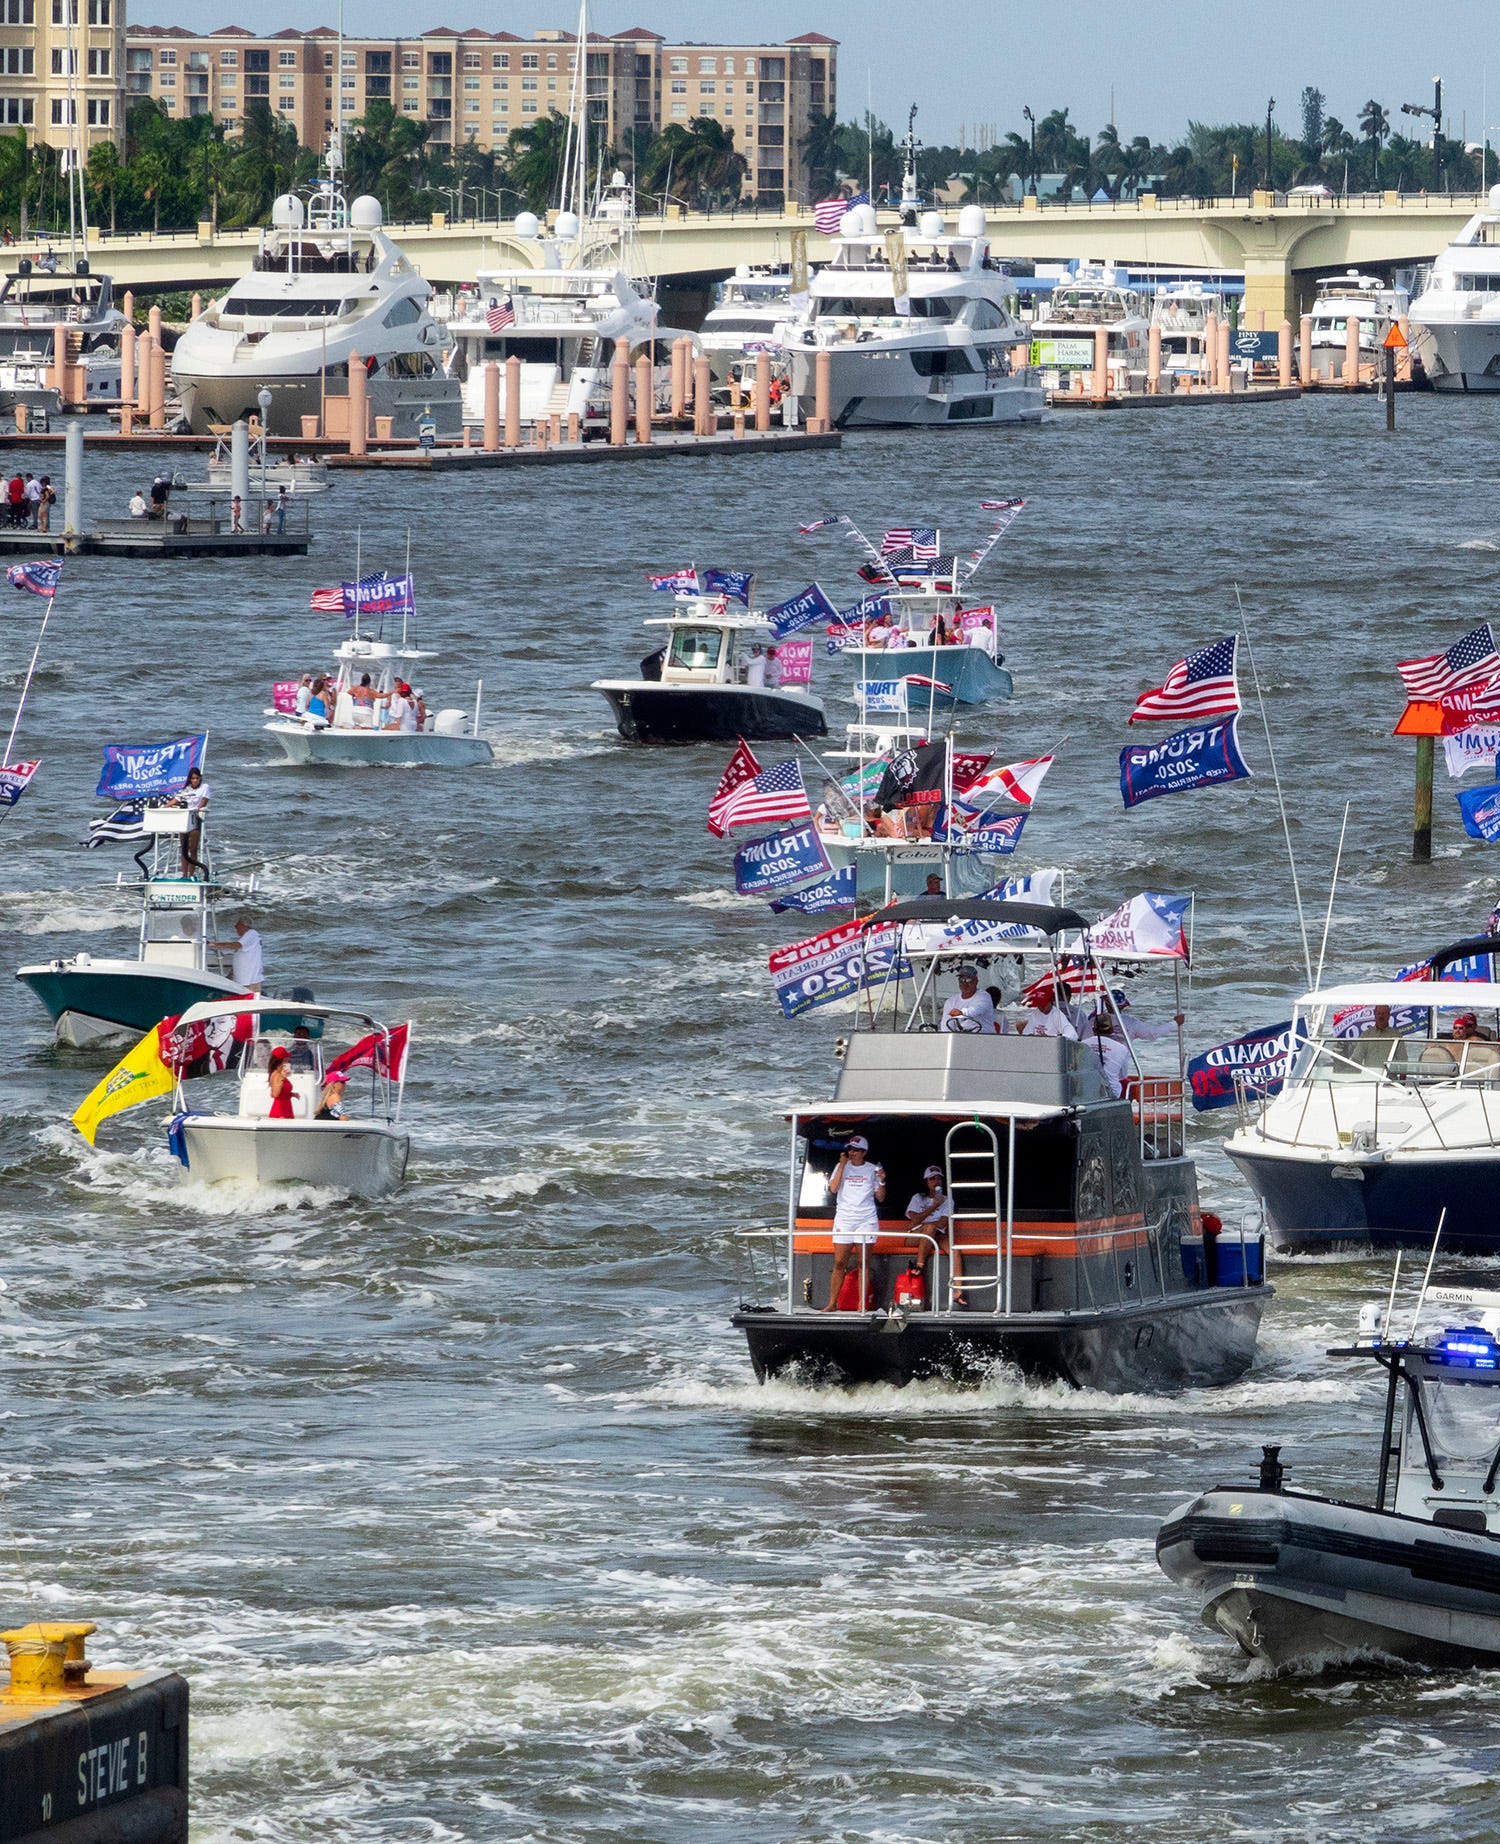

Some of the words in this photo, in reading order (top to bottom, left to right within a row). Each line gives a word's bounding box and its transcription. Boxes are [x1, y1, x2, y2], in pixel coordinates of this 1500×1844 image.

[896, 850, 939, 860] Cobia
[1435, 1291, 1473, 1303] GARMIN
[78, 1736, 131, 1805] STEVIE
[137, 1730, 148, 1785] B
[41, 1792, 52, 1822] 10
